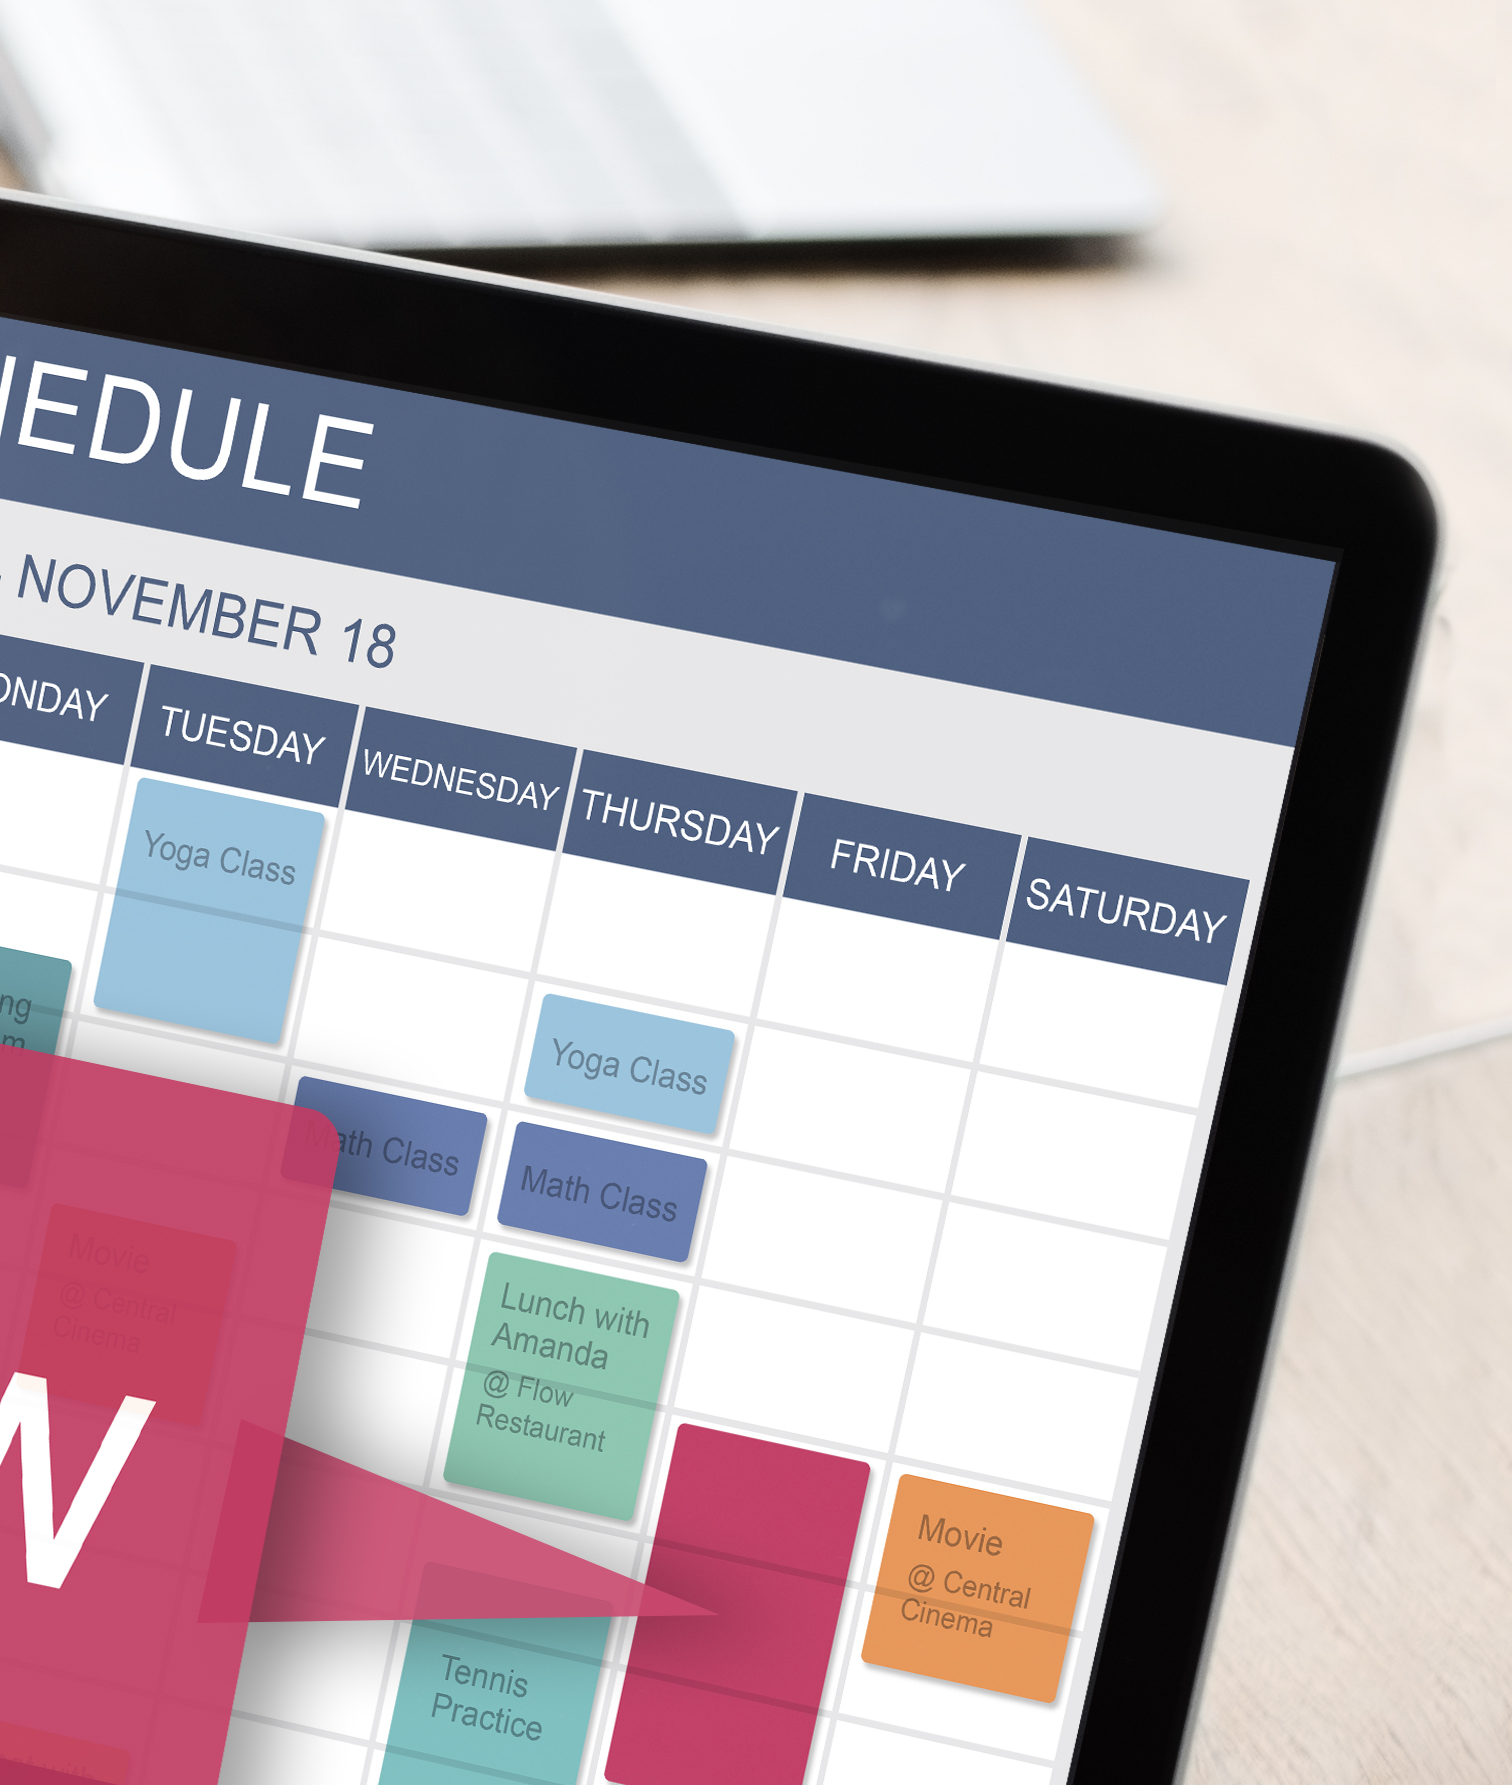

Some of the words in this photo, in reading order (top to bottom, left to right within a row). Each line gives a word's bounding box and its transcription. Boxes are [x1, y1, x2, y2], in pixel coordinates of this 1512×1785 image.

[18, 554, 321, 655] NOVEMBER
[344, 619, 395, 668] 18
[162, 706, 326, 764] TUESDAY
[365, 749, 560, 810] WEDNESDAY
[583, 789, 780, 854] THURSDAY
[145, 830, 209, 870] Yoga
[221, 847, 295, 885] Class
[831, 839, 966, 891] FRIDAY
[1027, 878, 1227, 943] SATURDAY
[553, 1038, 619, 1080] Yoga
[631, 1056, 707, 1095] Class
[383, 1137, 458, 1176] Class
[521, 1165, 589, 1203] Math
[601, 1183, 677, 1222] Class
[69, 1233, 149, 1274] Movie
[60, 1282, 85, 1309] @
[94, 1287, 177, 1324] Central
[501, 1282, 584, 1324] Lunch
[594, 1300, 650, 1338] with
[54, 1315, 140, 1354] Cinema
[491, 1323, 607, 1369] Amanda
[484, 1370, 509, 1398] @
[518, 1375, 574, 1407] Flow
[477, 1403, 605, 1452] Restaurant
[919, 1514, 1002, 1556] Movie
[909, 1564, 934, 1593] @
[944, 1571, 1031, 1609] Central
[902, 1598, 992, 1637] Cinema
[442, 1654, 527, 1697] Tennis
[432, 1693, 542, 1741] Practice
